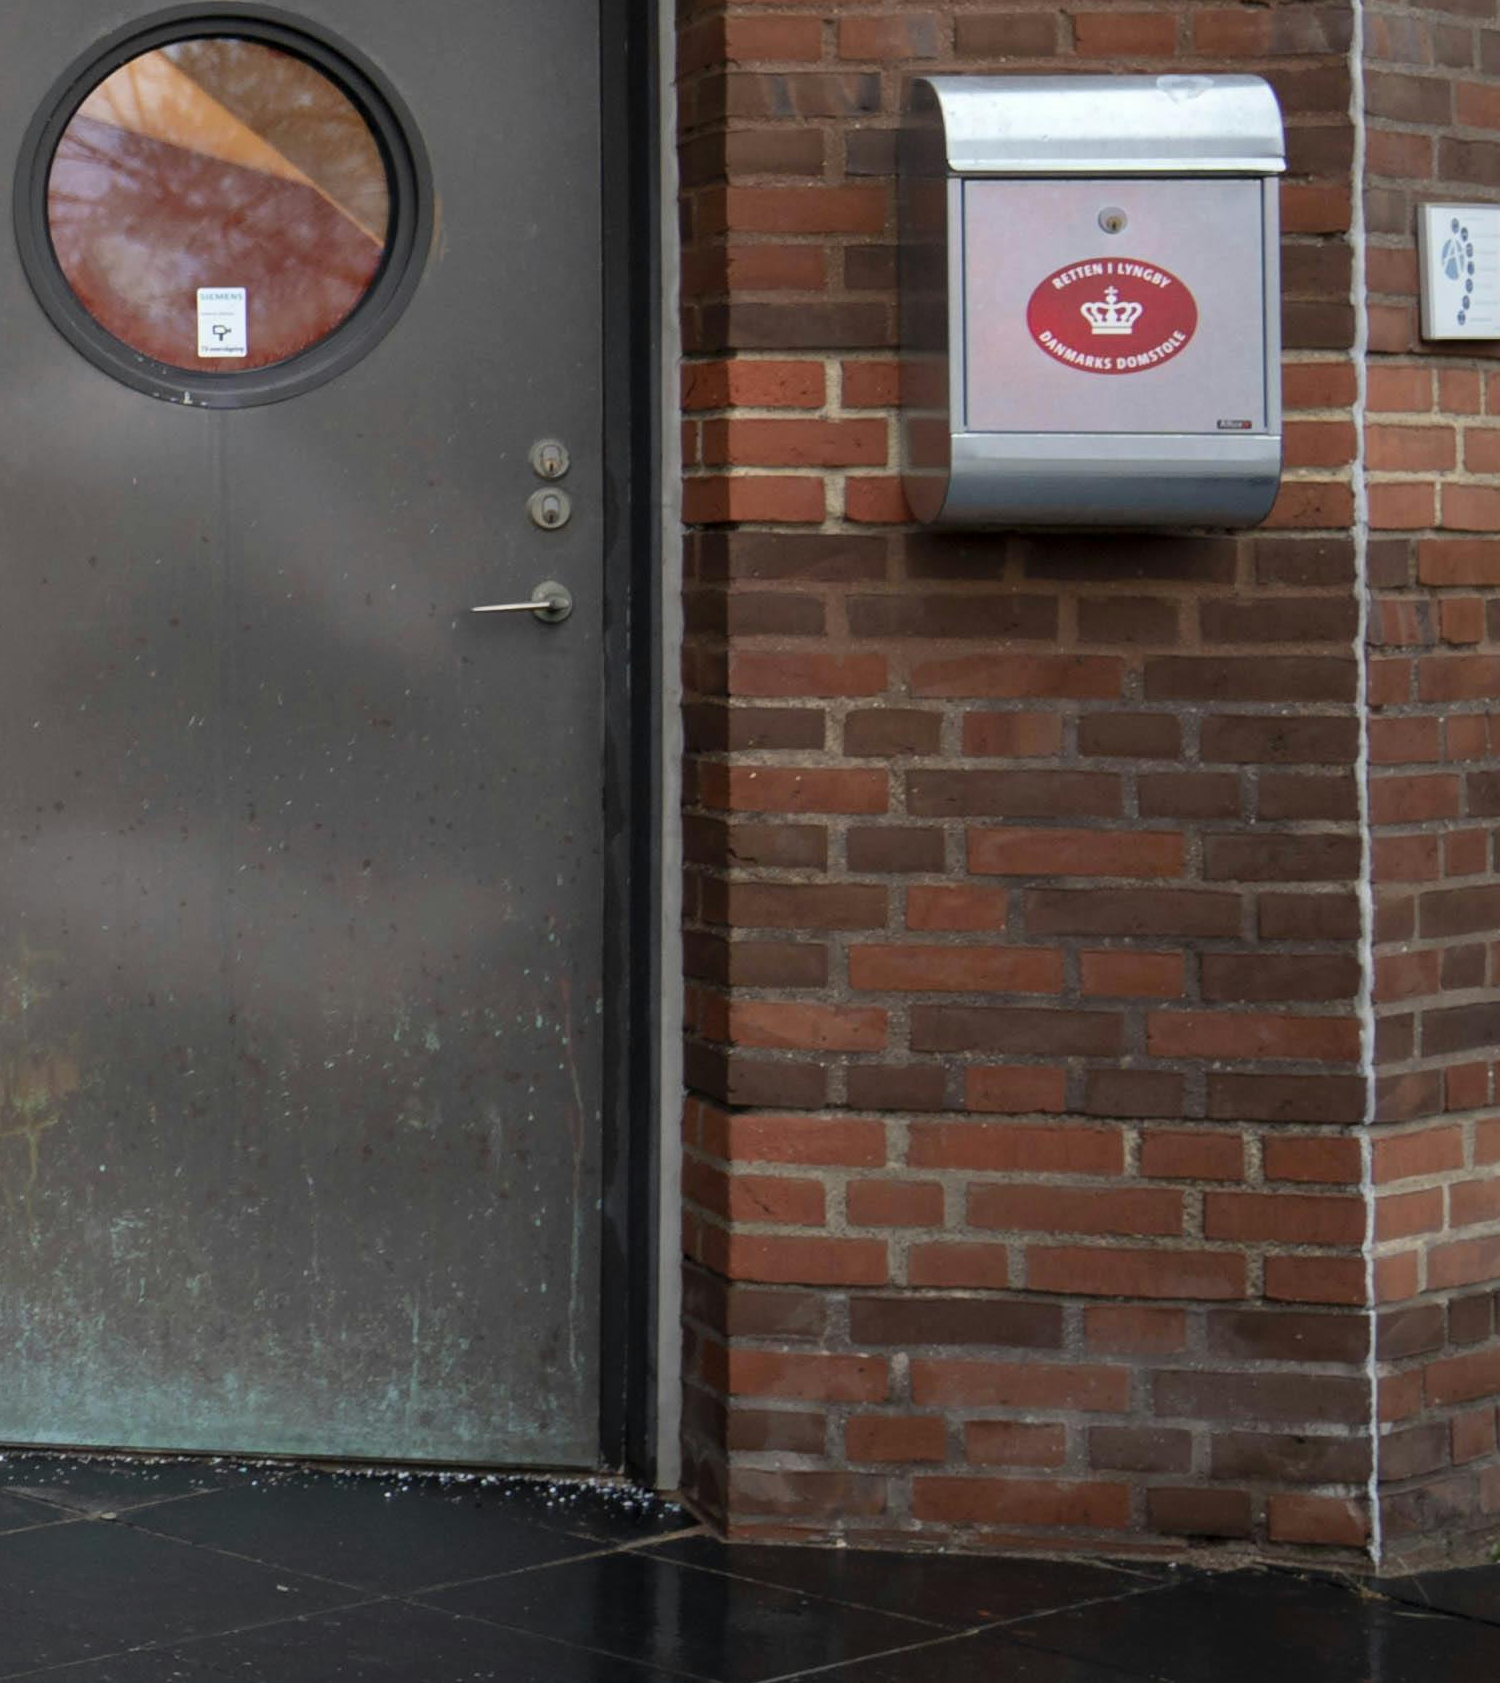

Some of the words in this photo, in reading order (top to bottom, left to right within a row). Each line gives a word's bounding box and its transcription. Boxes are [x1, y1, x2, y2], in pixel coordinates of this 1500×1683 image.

[1052, 262, 1104, 291] RETTEN
[1106, 262, 1113, 275] I
[1116, 263, 1173, 290] LYNGBY
[1038, 330, 1113, 371] DANMARKS
[1116, 330, 1186, 371] DOMSTOLE
